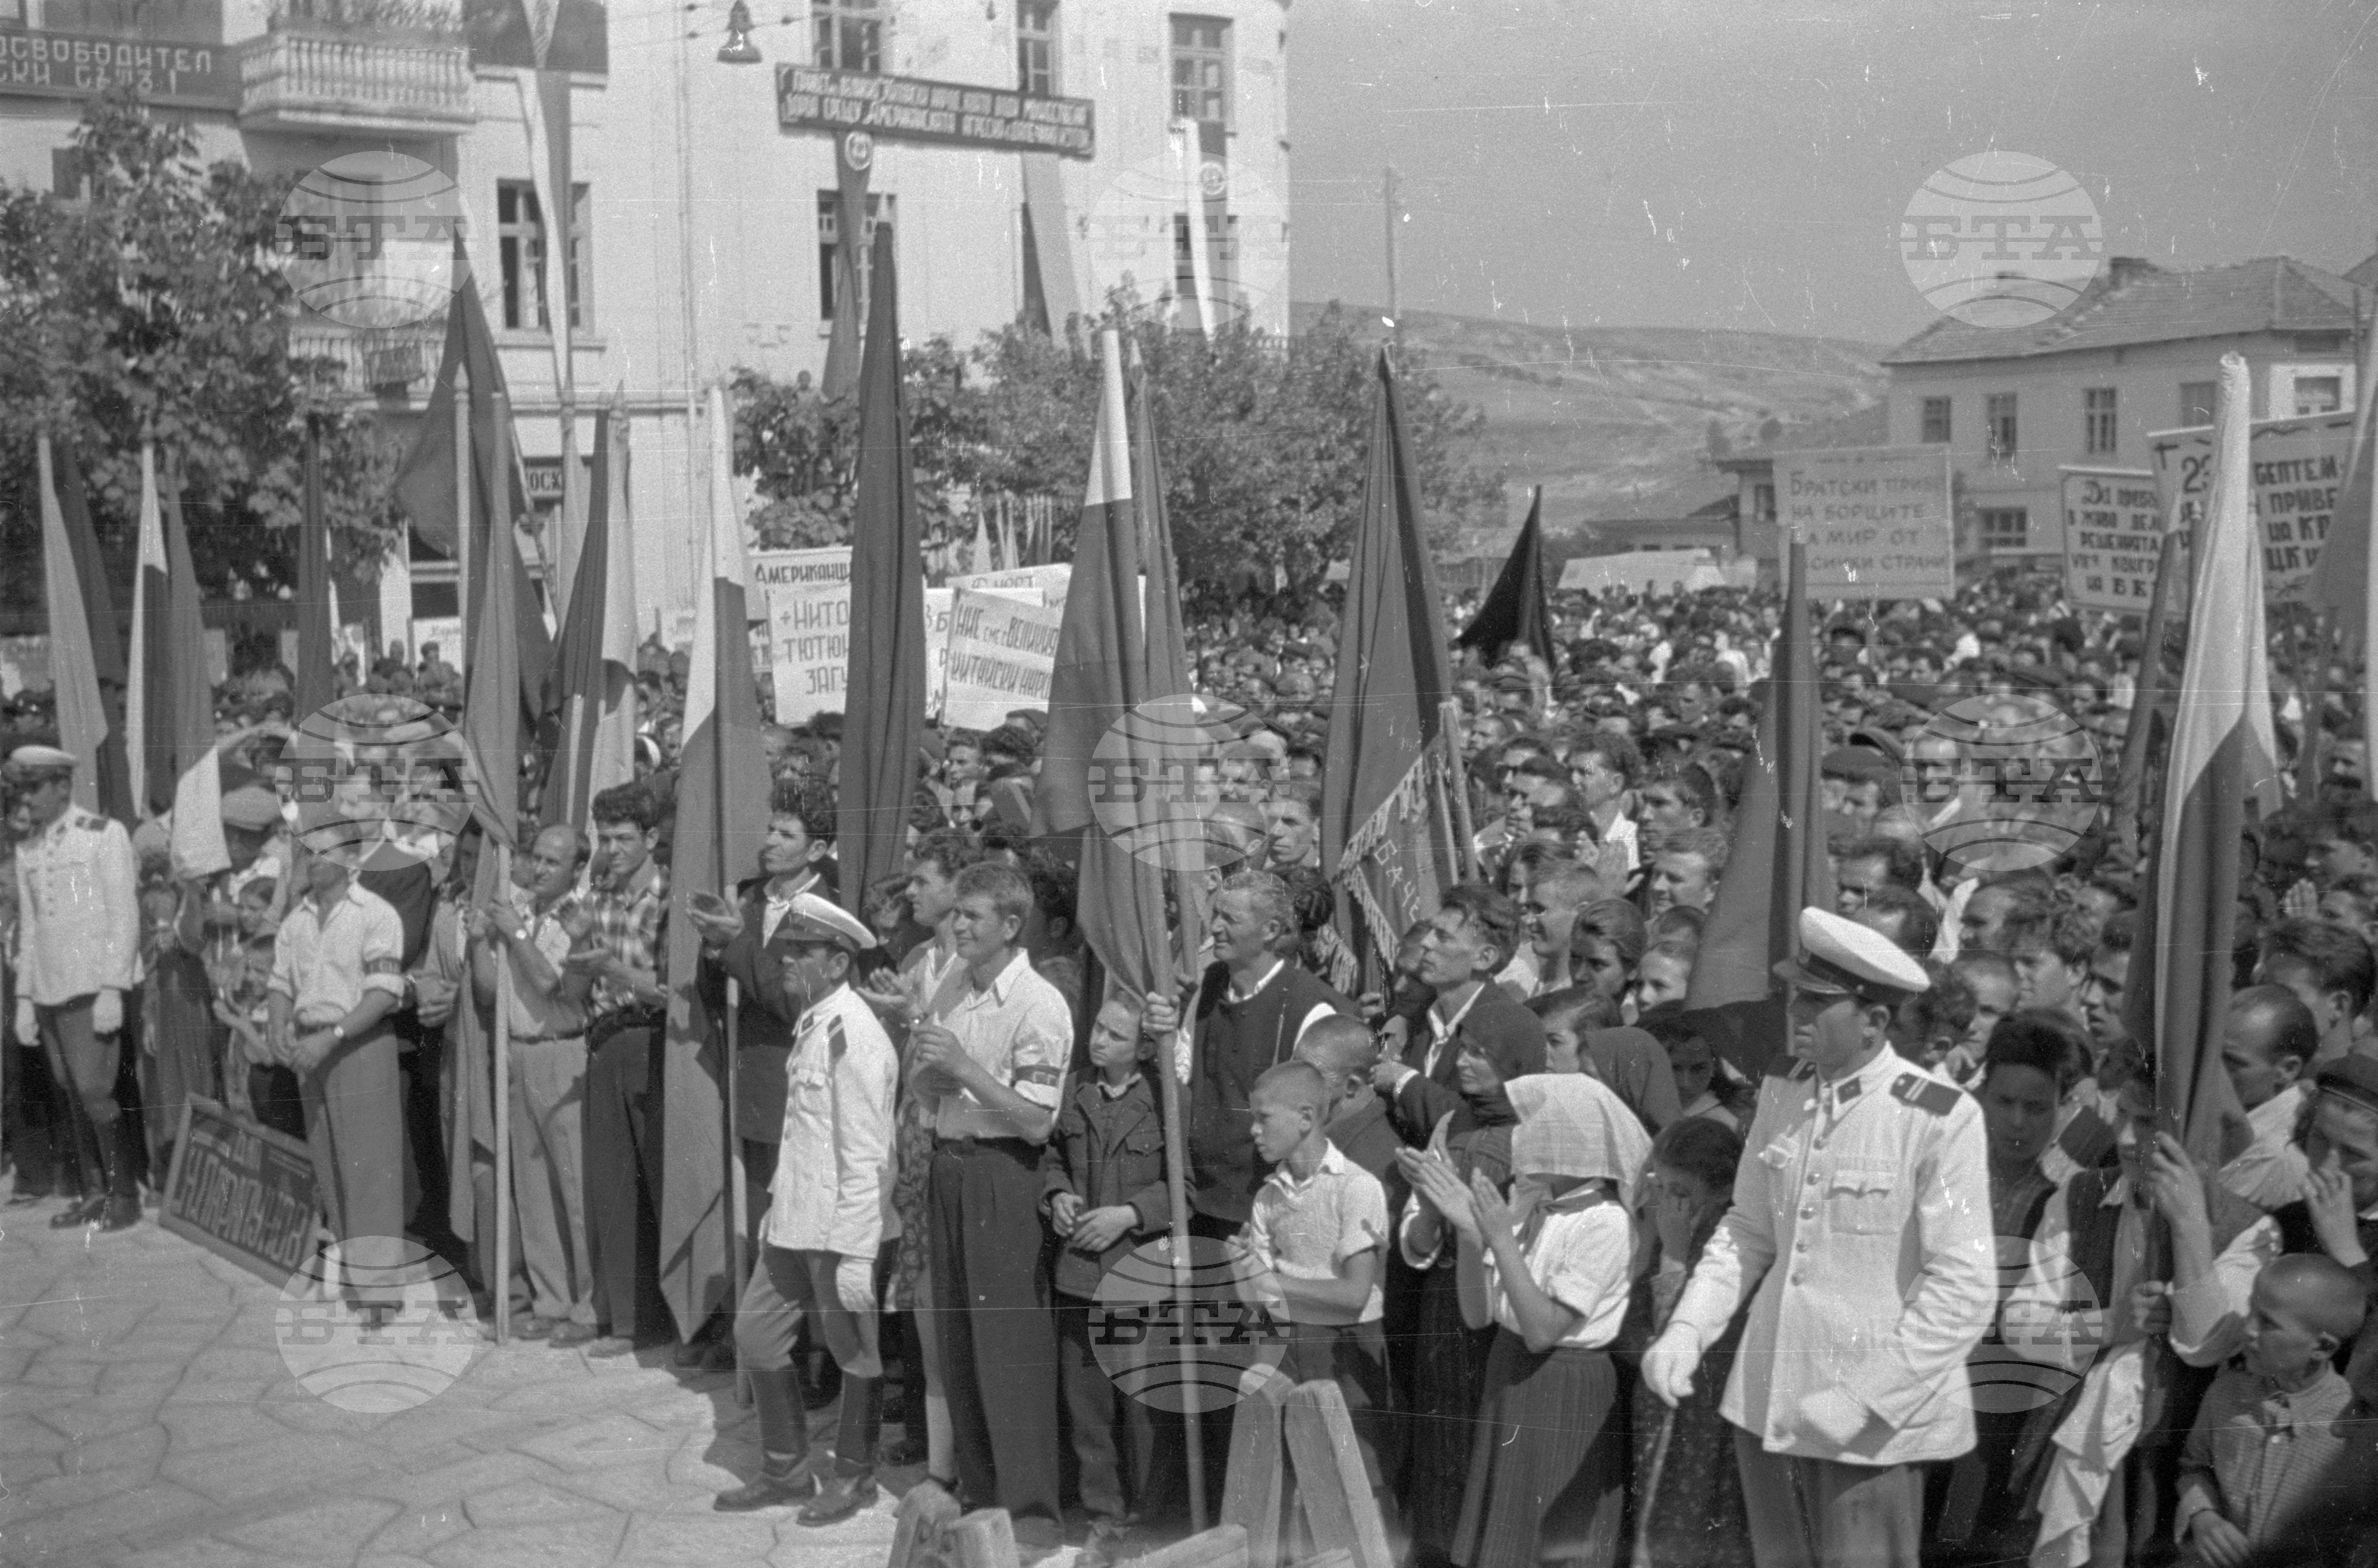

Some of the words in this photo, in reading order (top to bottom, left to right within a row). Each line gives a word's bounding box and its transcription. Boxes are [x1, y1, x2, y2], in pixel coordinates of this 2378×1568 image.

[1826, 529, 1876, 545] МИР
[1890, 530, 1918, 546] ОТ
[1810, 555, 1874, 571] СИЧКИ
